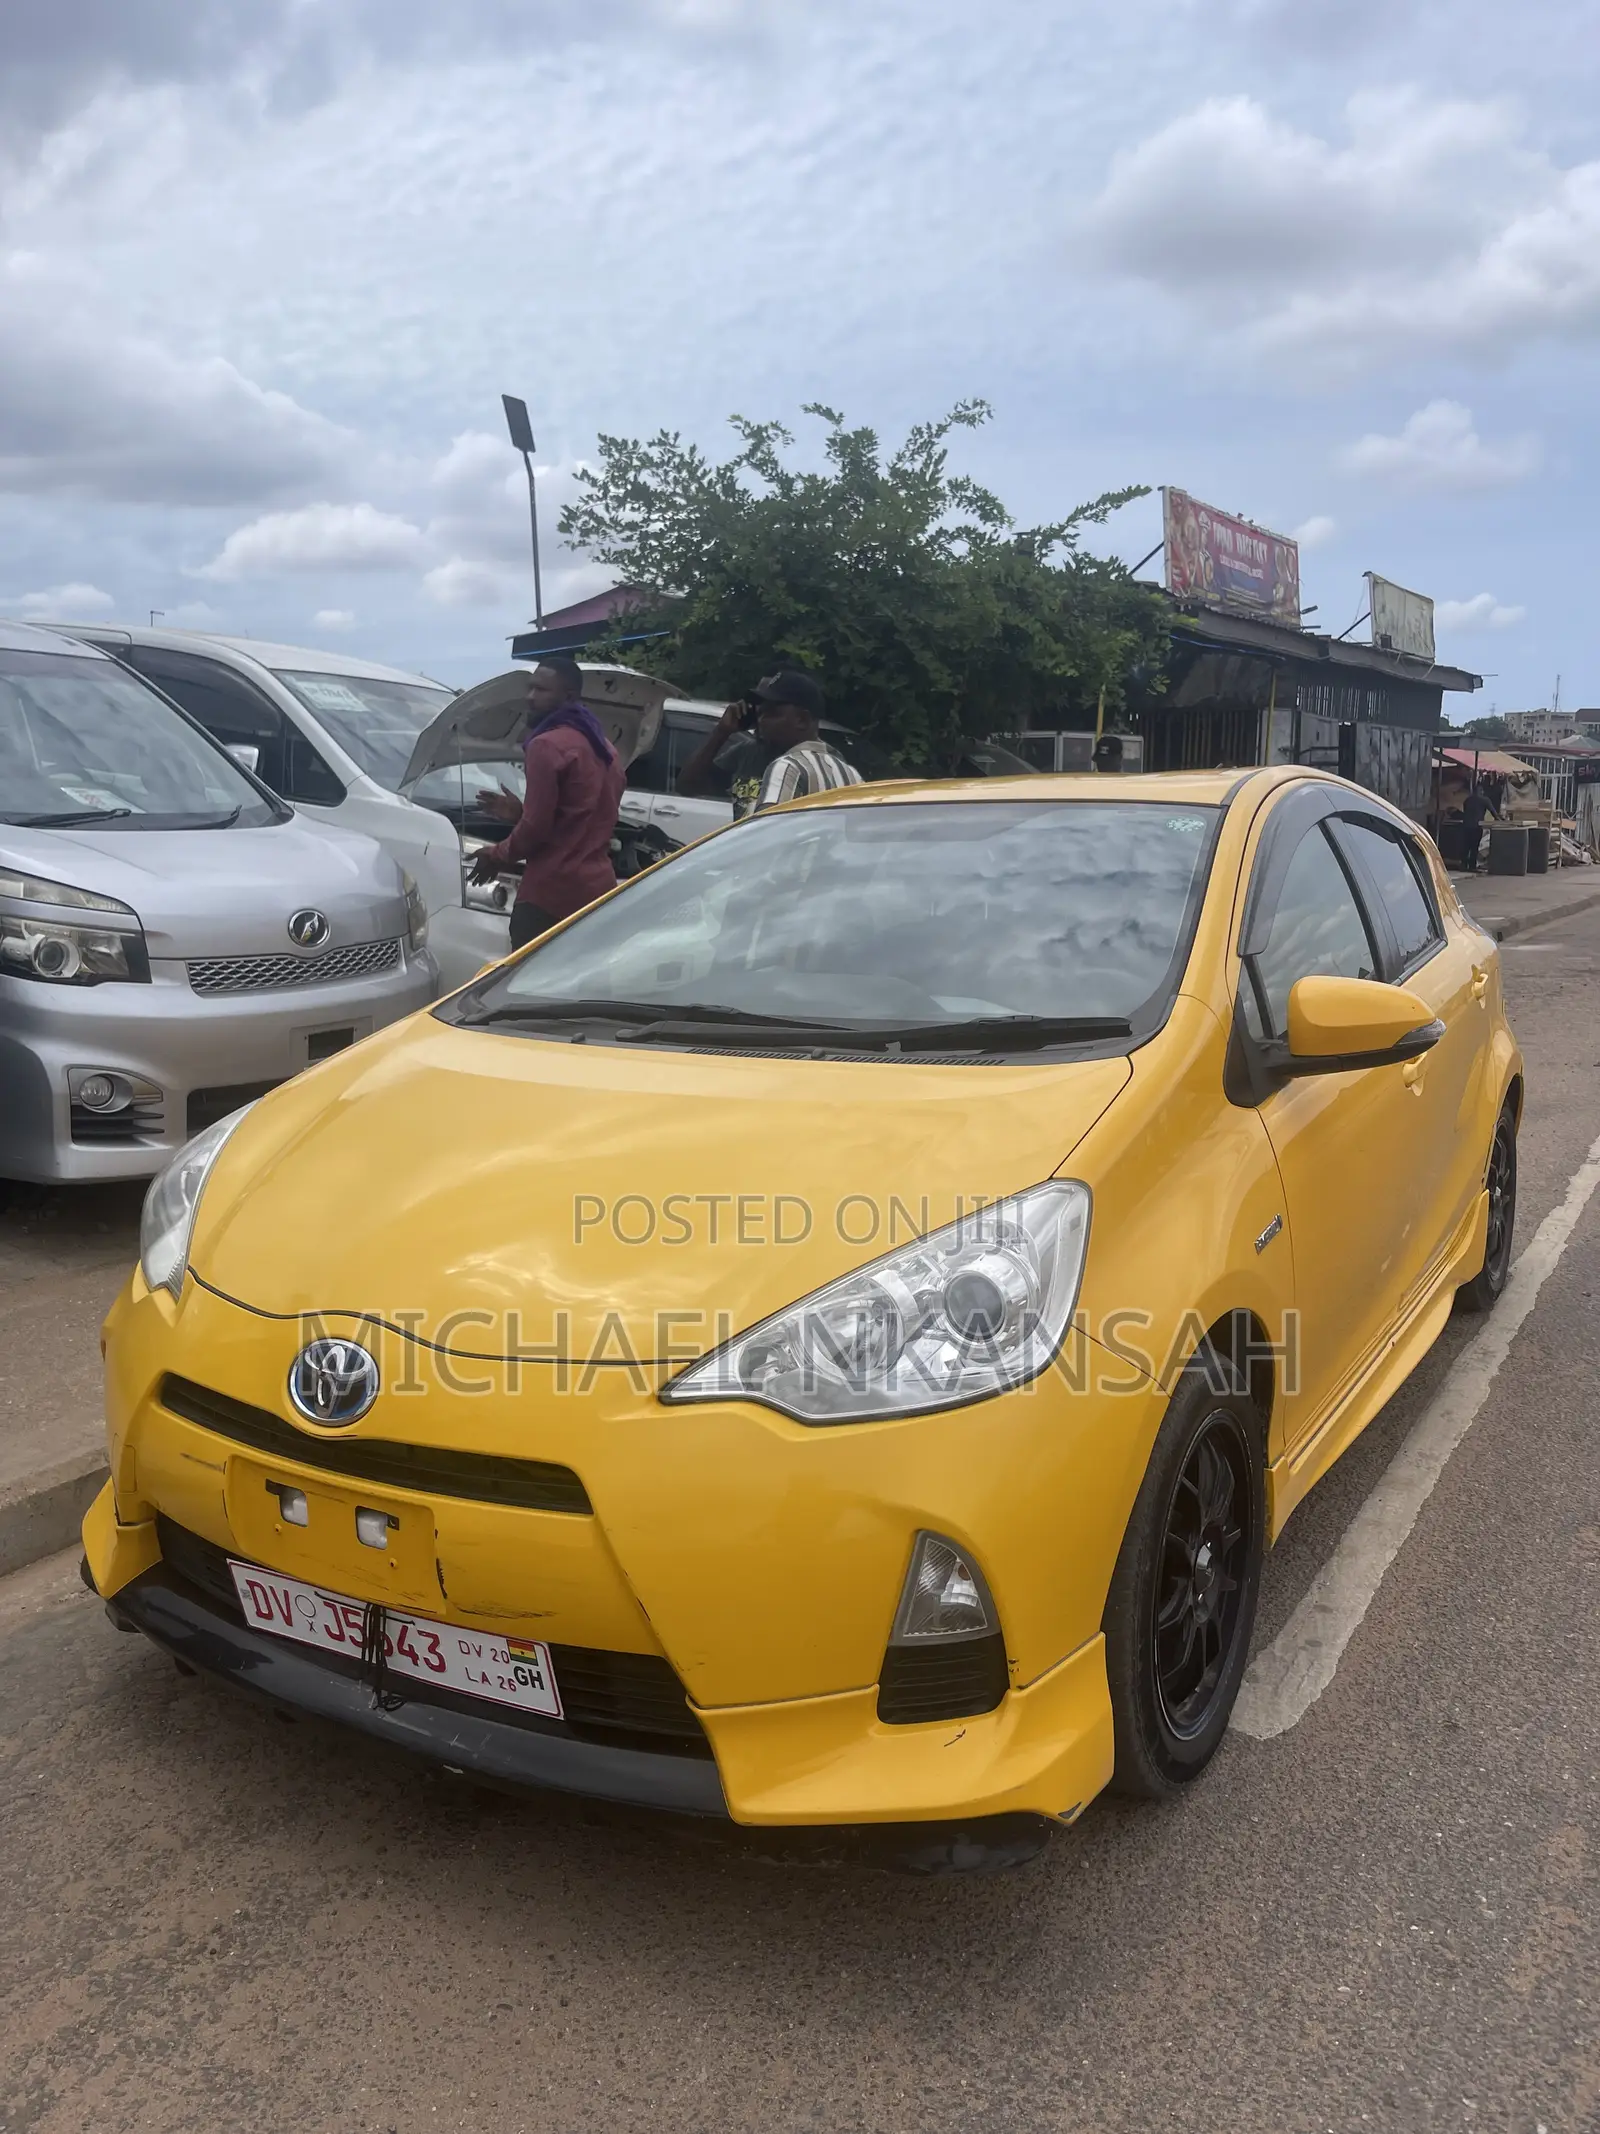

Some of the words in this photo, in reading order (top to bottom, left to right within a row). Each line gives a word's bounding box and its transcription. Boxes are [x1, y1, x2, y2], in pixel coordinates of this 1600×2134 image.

[246, 1579, 294, 1628] DV
[458, 1640, 482, 1658] DV
[490, 1647, 511, 1665] 20
[464, 1666, 493, 1687] LA
[497, 1675, 517, 1693] 26
[513, 1665, 545, 1691] GH
